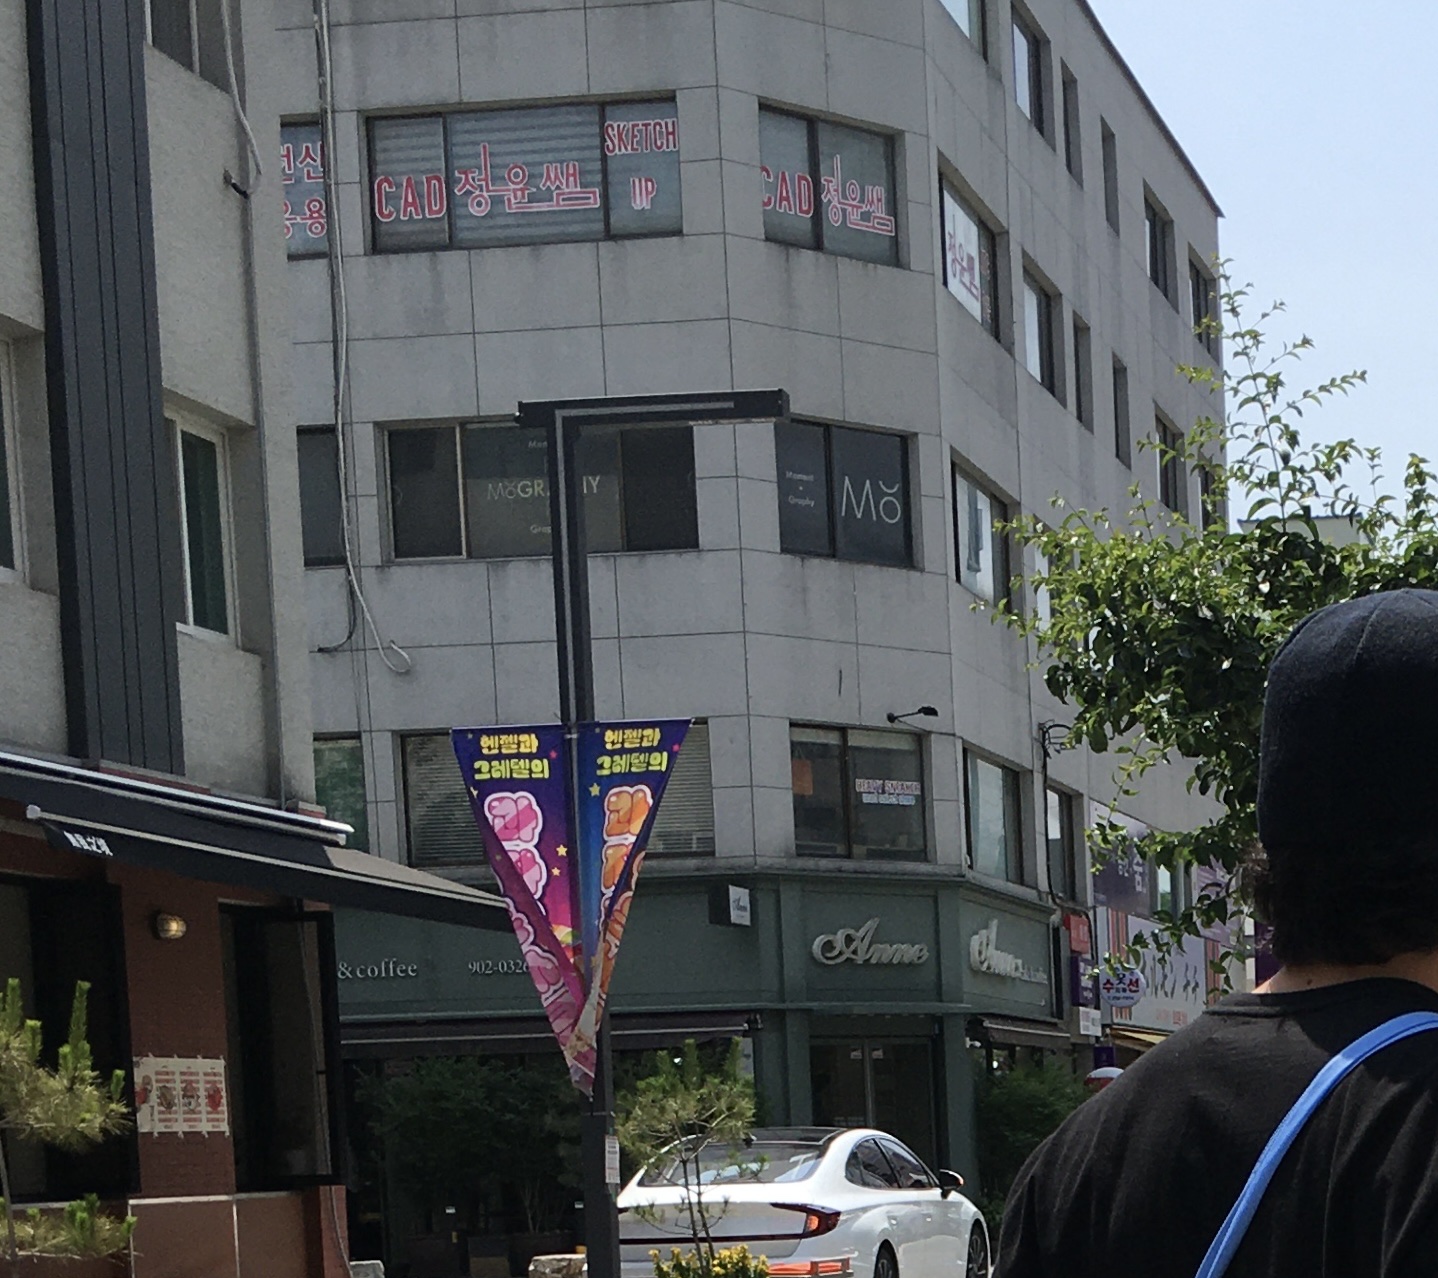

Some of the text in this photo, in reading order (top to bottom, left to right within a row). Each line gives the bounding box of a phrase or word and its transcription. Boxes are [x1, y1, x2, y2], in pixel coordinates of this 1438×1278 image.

[604, 118, 679, 156] SKETCH
[374, 142, 600, 222] CAD 정윤쌤
[629, 177, 656, 210] UP
[760, 154, 896, 236] CAD 정윤쌤
[479, 733, 539, 753] 헨젤과
[604, 728, 661, 750] 헨젤과
[473, 758, 550, 779] 그레텔의
[596, 752, 668, 776] 그레텔의
[811, 916, 931, 966] Anne
